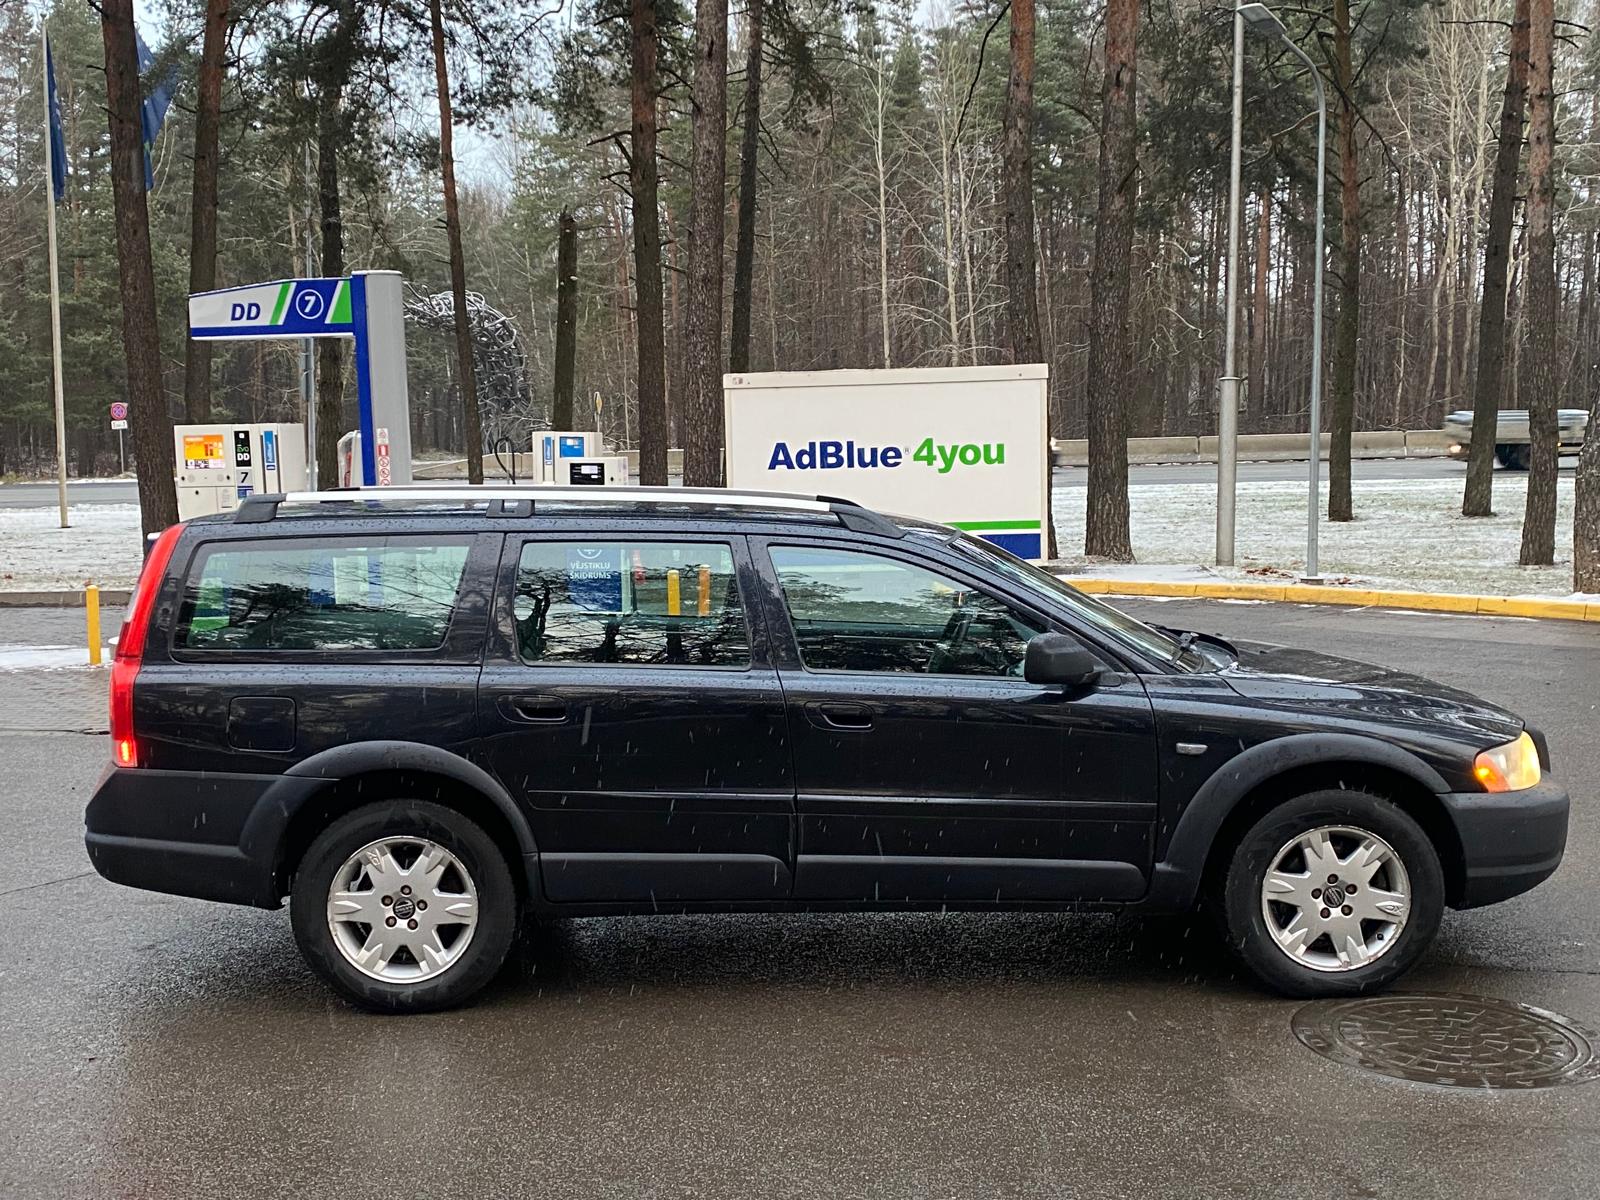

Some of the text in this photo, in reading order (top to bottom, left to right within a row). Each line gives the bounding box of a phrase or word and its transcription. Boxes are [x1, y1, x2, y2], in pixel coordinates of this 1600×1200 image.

[231, 295, 316, 321] DD 7
[237, 452, 251, 461] DD
[913, 437, 1005, 474] 4you
[240, 471, 249, 484] 7
